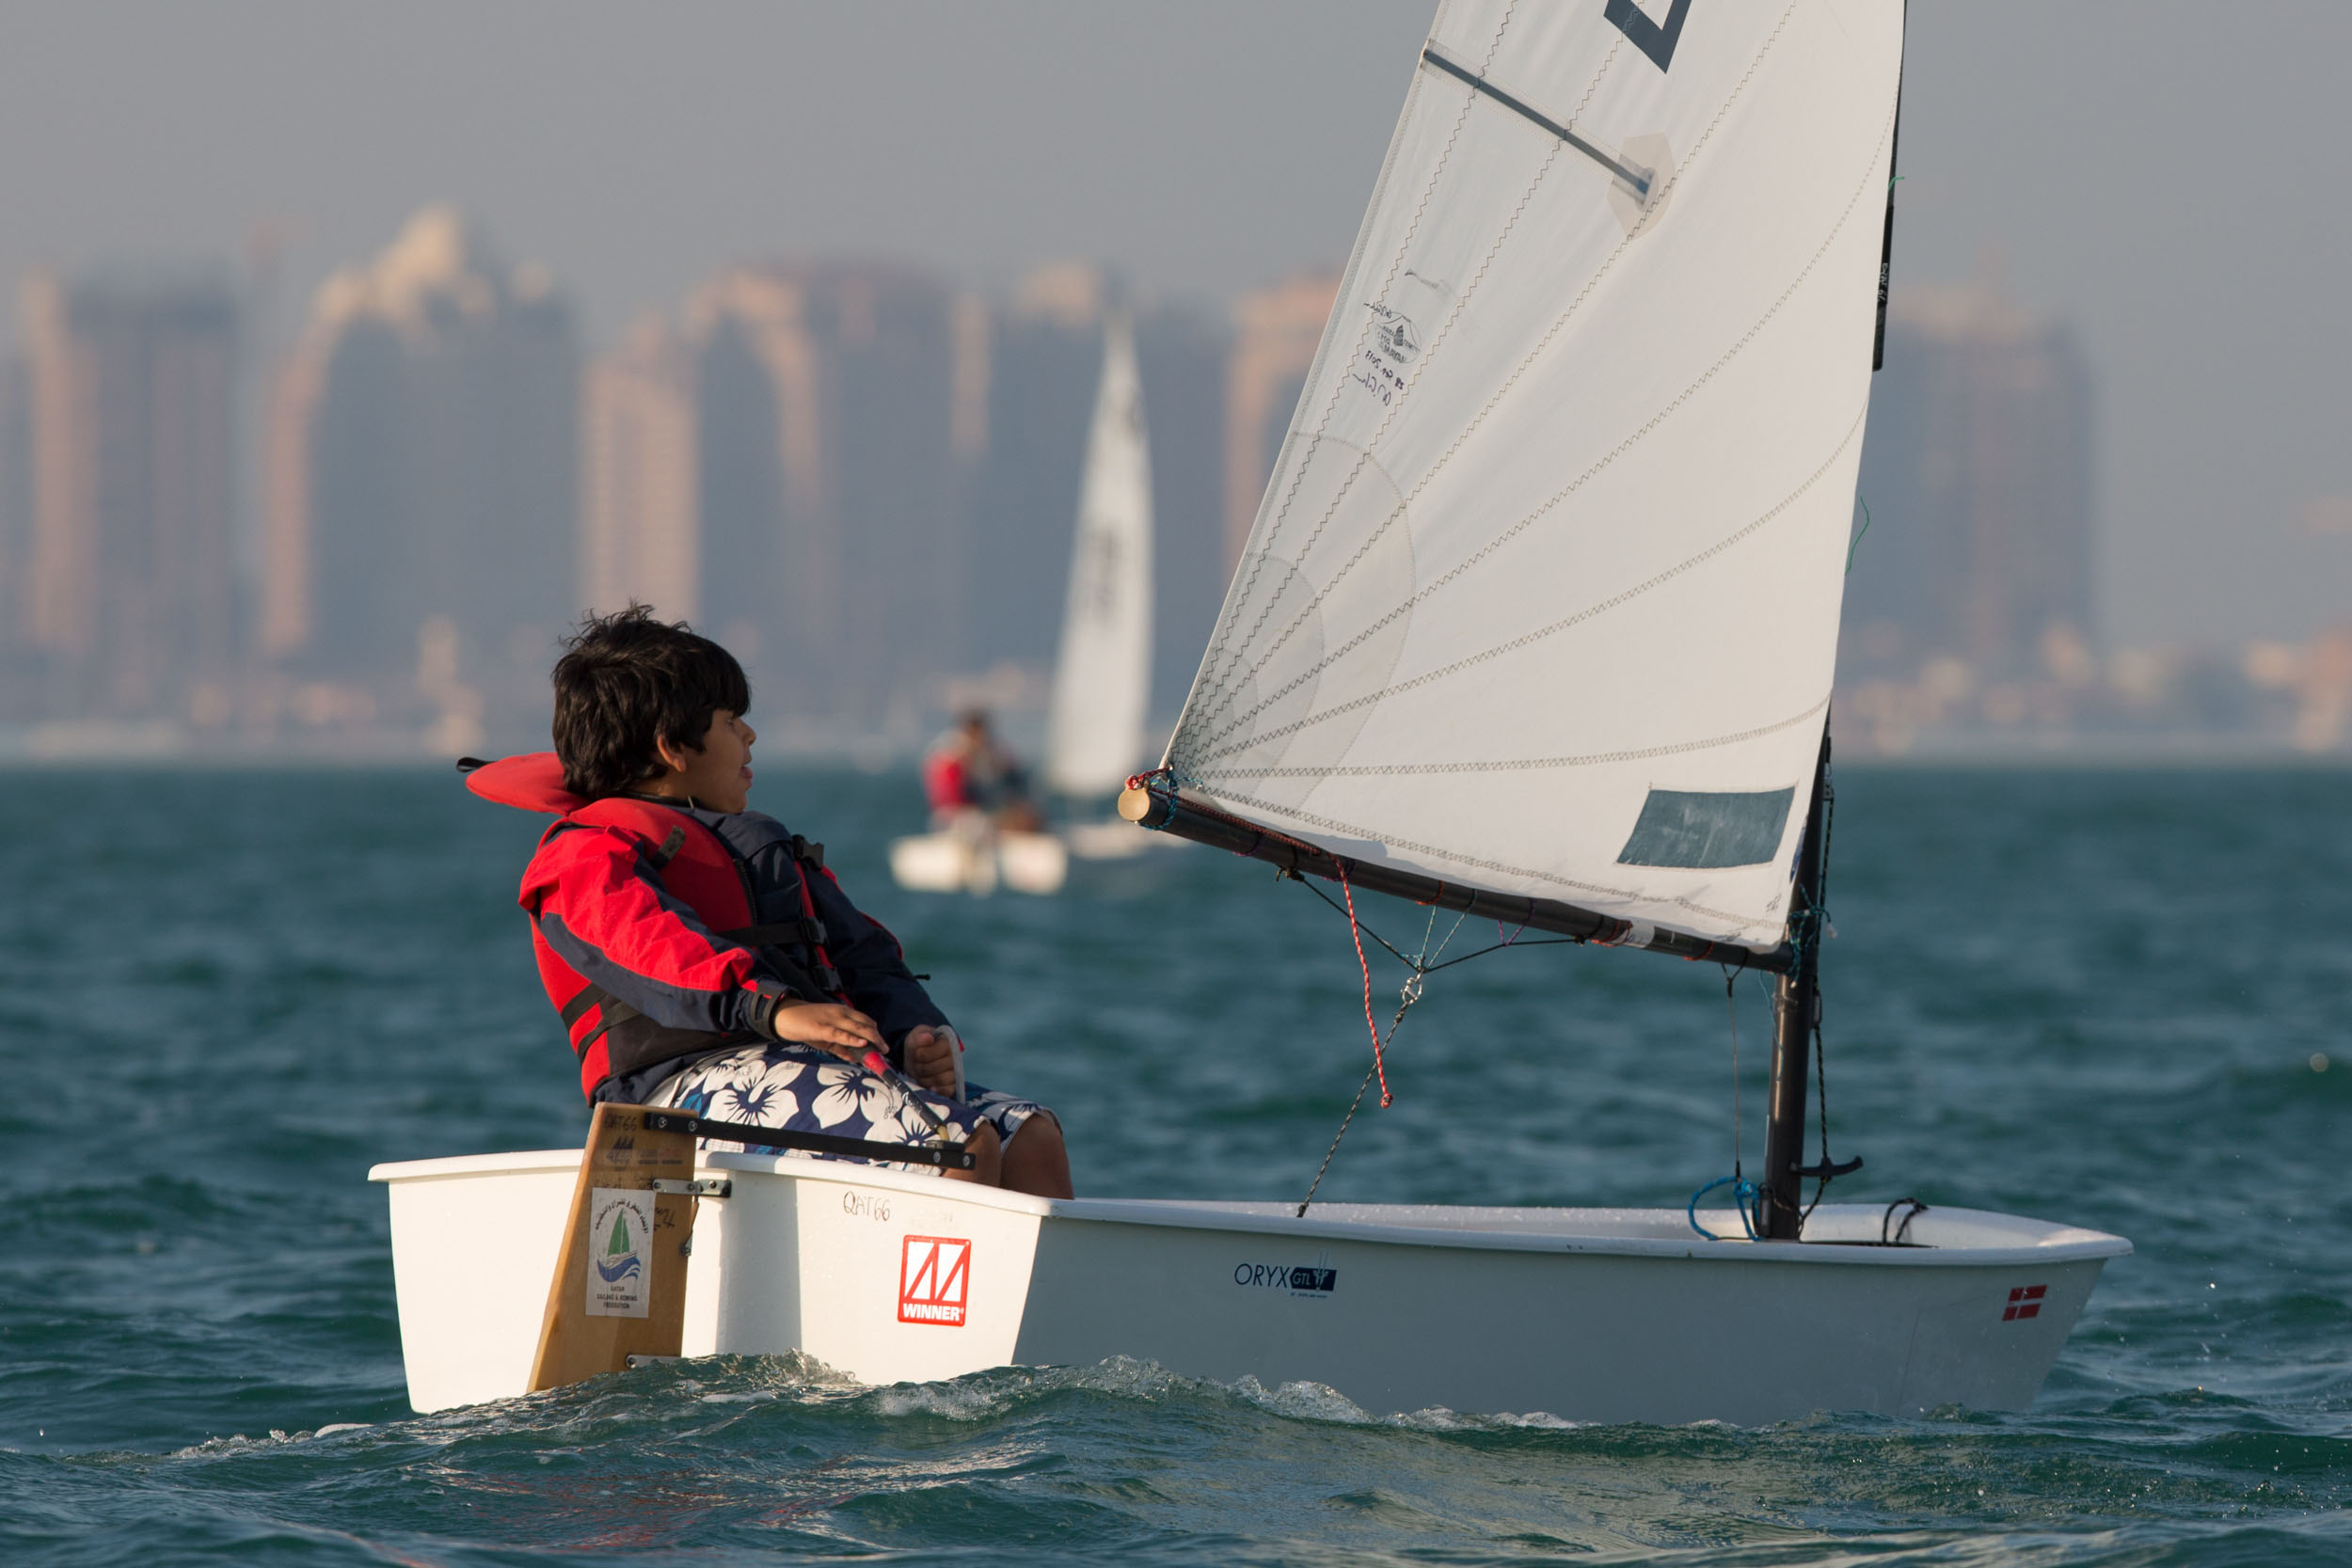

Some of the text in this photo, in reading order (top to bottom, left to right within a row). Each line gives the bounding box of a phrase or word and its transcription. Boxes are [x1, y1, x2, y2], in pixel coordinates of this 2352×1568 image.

[843, 1191, 890, 1222] QAT66
[1234, 1263, 1311, 1289] ORYX GTL
[903, 1303, 961, 1322] WINNER
